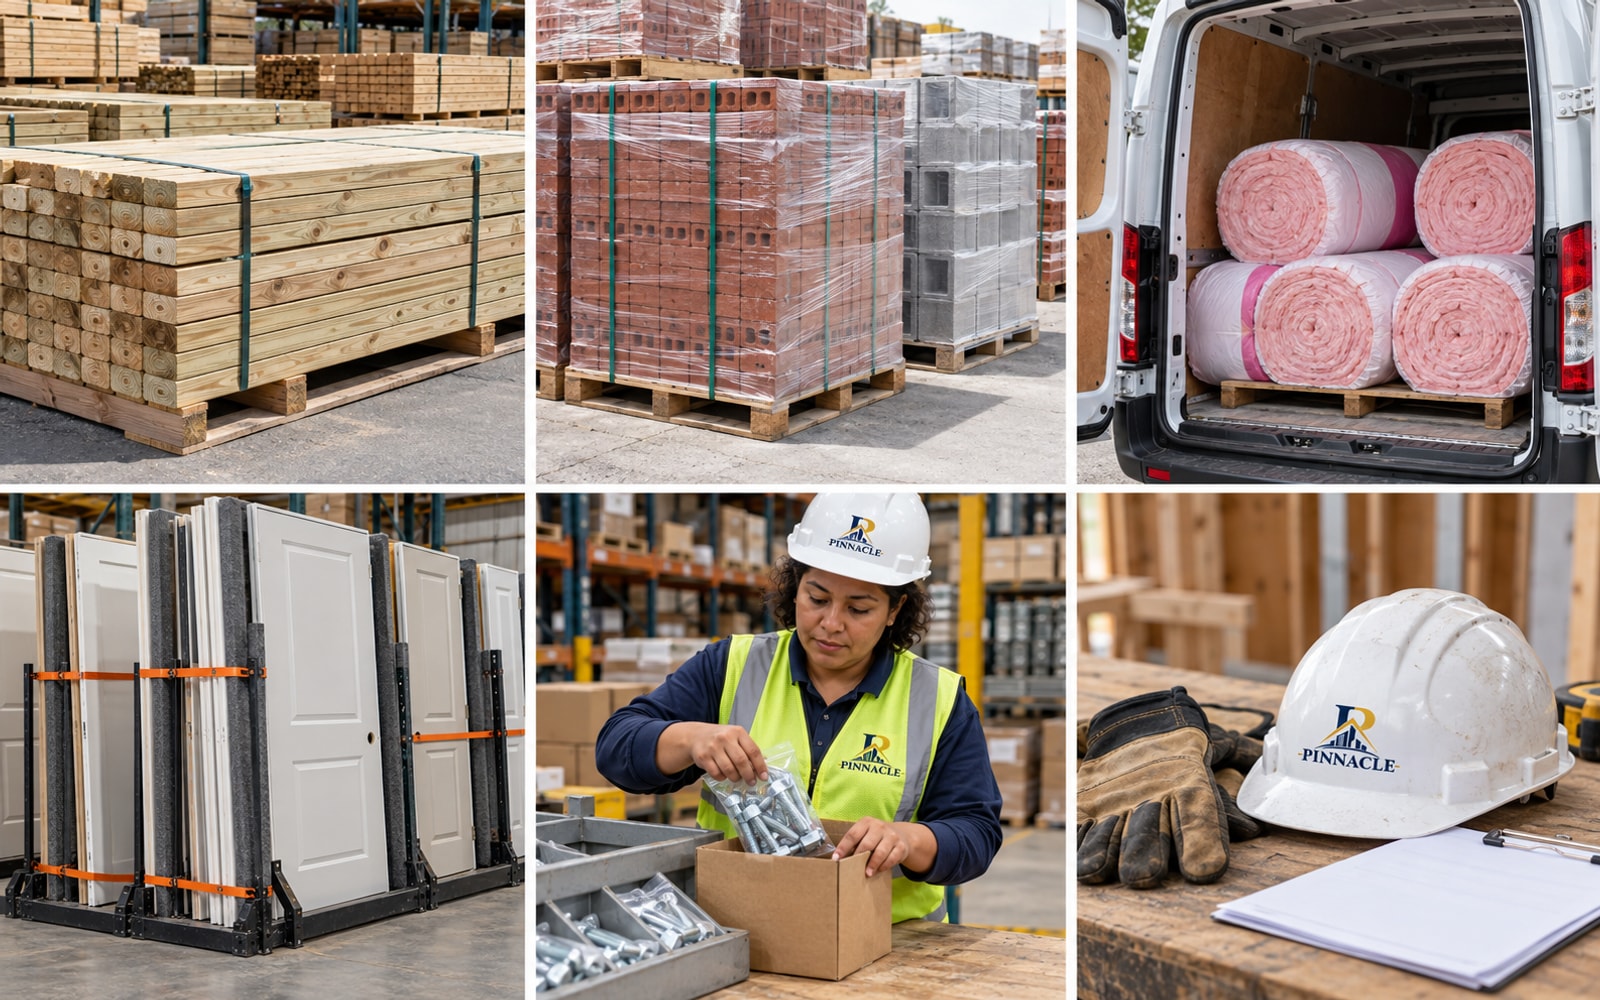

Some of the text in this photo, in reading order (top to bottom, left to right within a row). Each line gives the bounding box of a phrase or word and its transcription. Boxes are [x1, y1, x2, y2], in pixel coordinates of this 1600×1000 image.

[829, 538, 881, 557] PINNACLE
[840, 760, 901, 777] PINNACLE
[1302, 748, 1396, 773] PINNACLE
